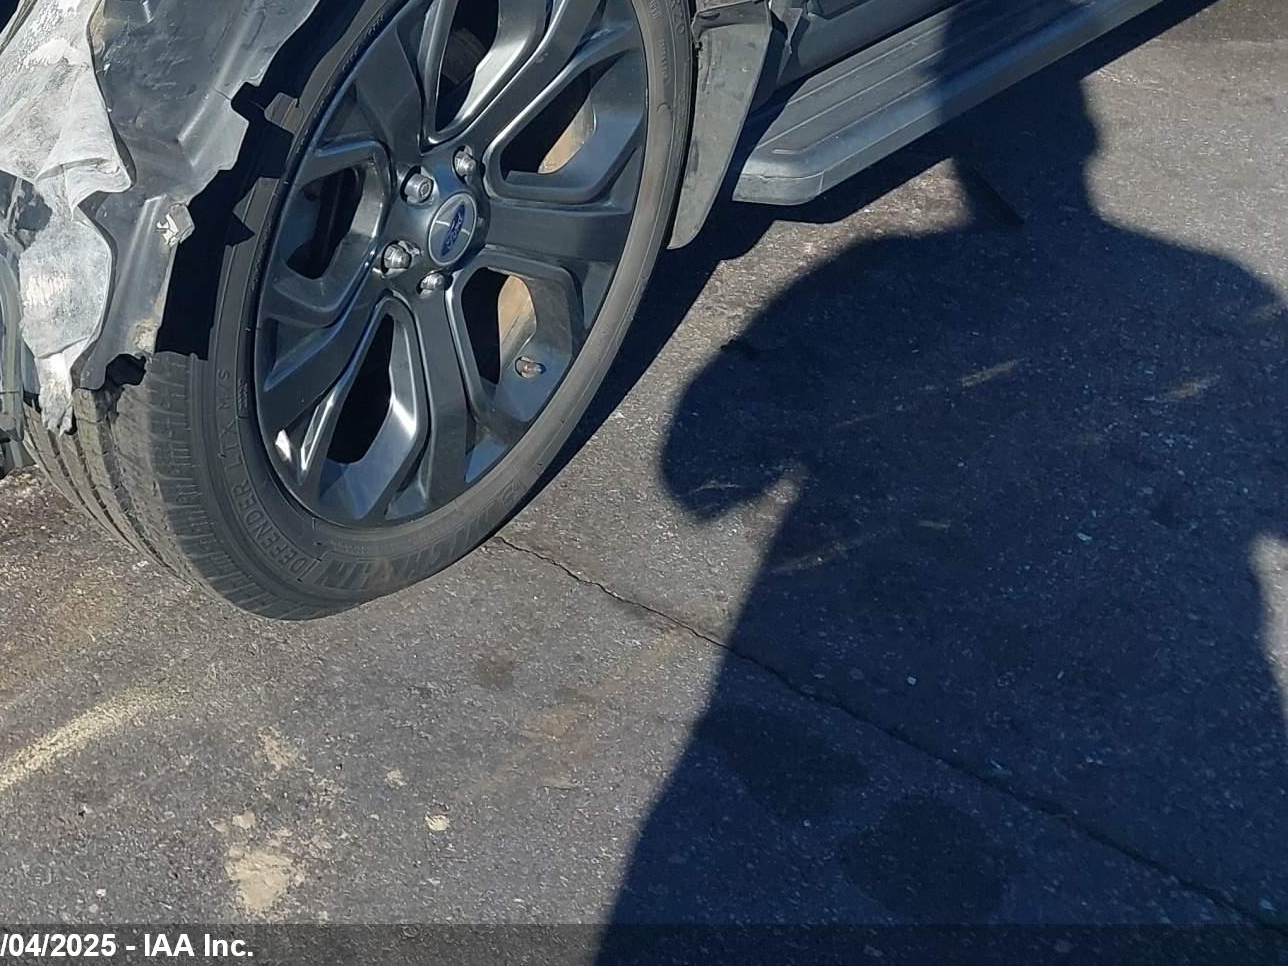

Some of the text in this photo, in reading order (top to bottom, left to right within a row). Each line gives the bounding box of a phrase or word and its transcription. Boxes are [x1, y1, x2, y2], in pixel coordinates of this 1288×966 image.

[216, 368, 231, 411] M/S
[218, 421, 243, 478] LTX
[231, 480, 309, 574] DEFENDER
